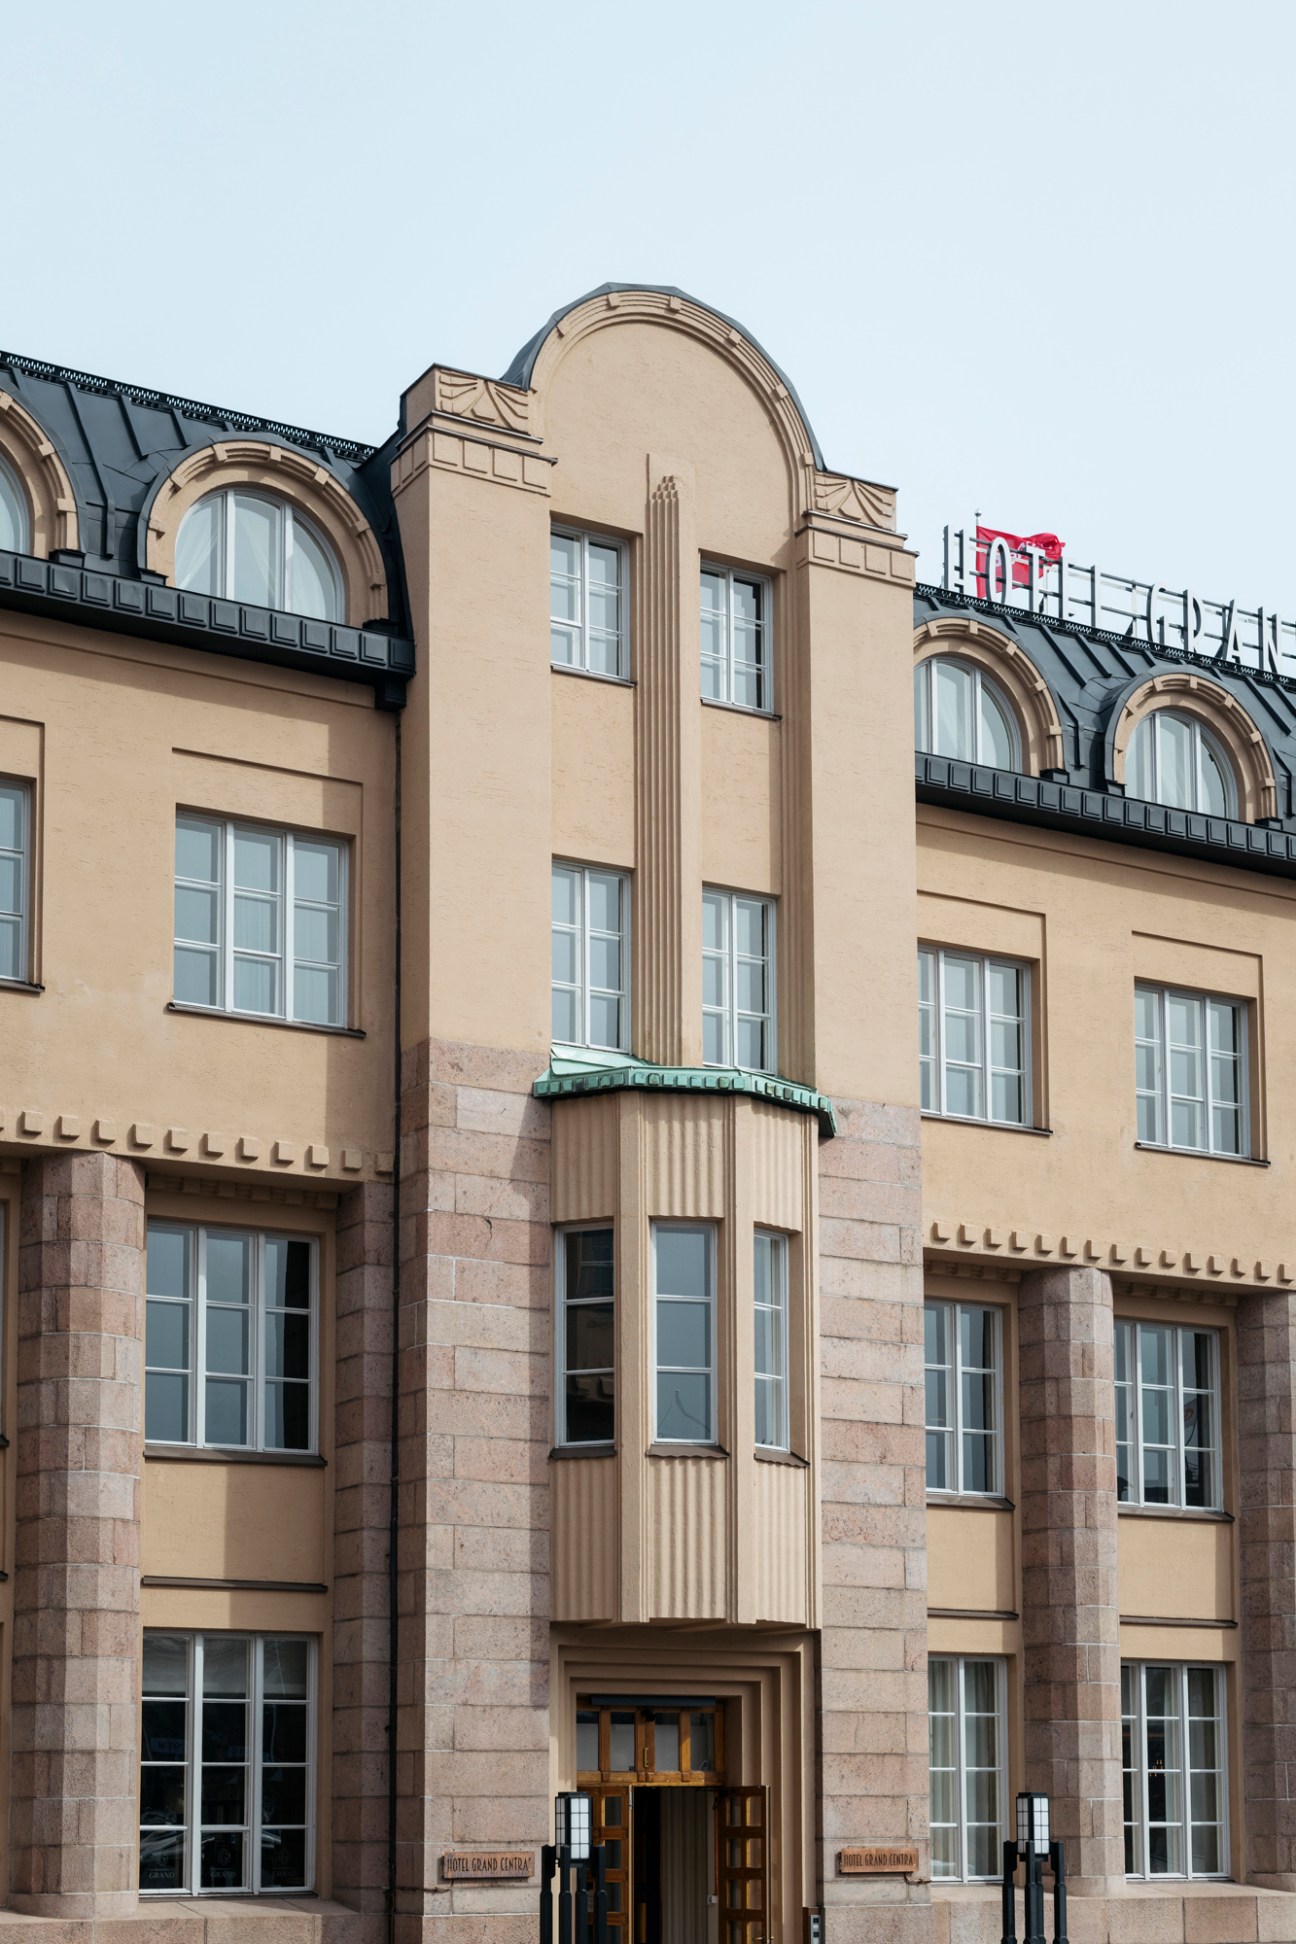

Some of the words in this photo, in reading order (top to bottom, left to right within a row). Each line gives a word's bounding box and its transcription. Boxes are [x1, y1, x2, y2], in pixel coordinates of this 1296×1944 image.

[1146, 583, 1296, 677] GRAN
[447, 1857, 469, 1872] HOTEL
[471, 1857, 498, 1872] GRAND
[844, 1853, 863, 1867] HOTEL
[864, 1853, 888, 1867] GRAND
[148, 1871, 176, 1880] GRAND
